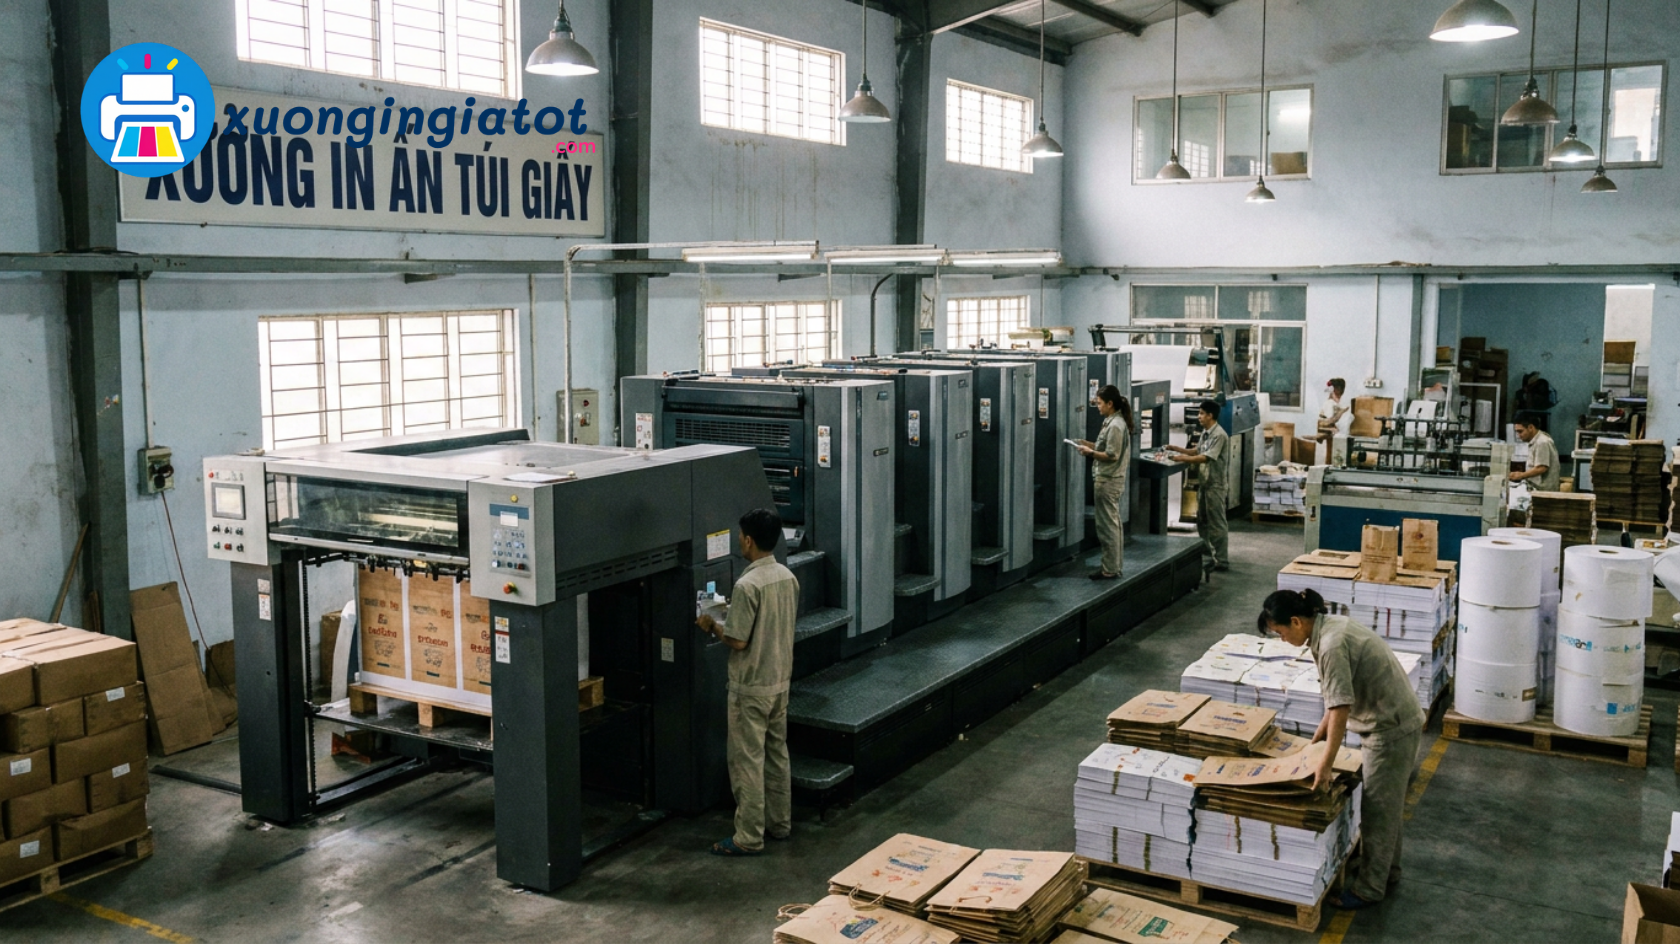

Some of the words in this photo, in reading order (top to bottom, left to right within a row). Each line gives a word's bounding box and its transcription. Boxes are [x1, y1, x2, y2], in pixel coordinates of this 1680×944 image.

[331, 141, 375, 211] IN
[454, 141, 510, 217] TÚI
[521, 141, 592, 221] GIẤY
